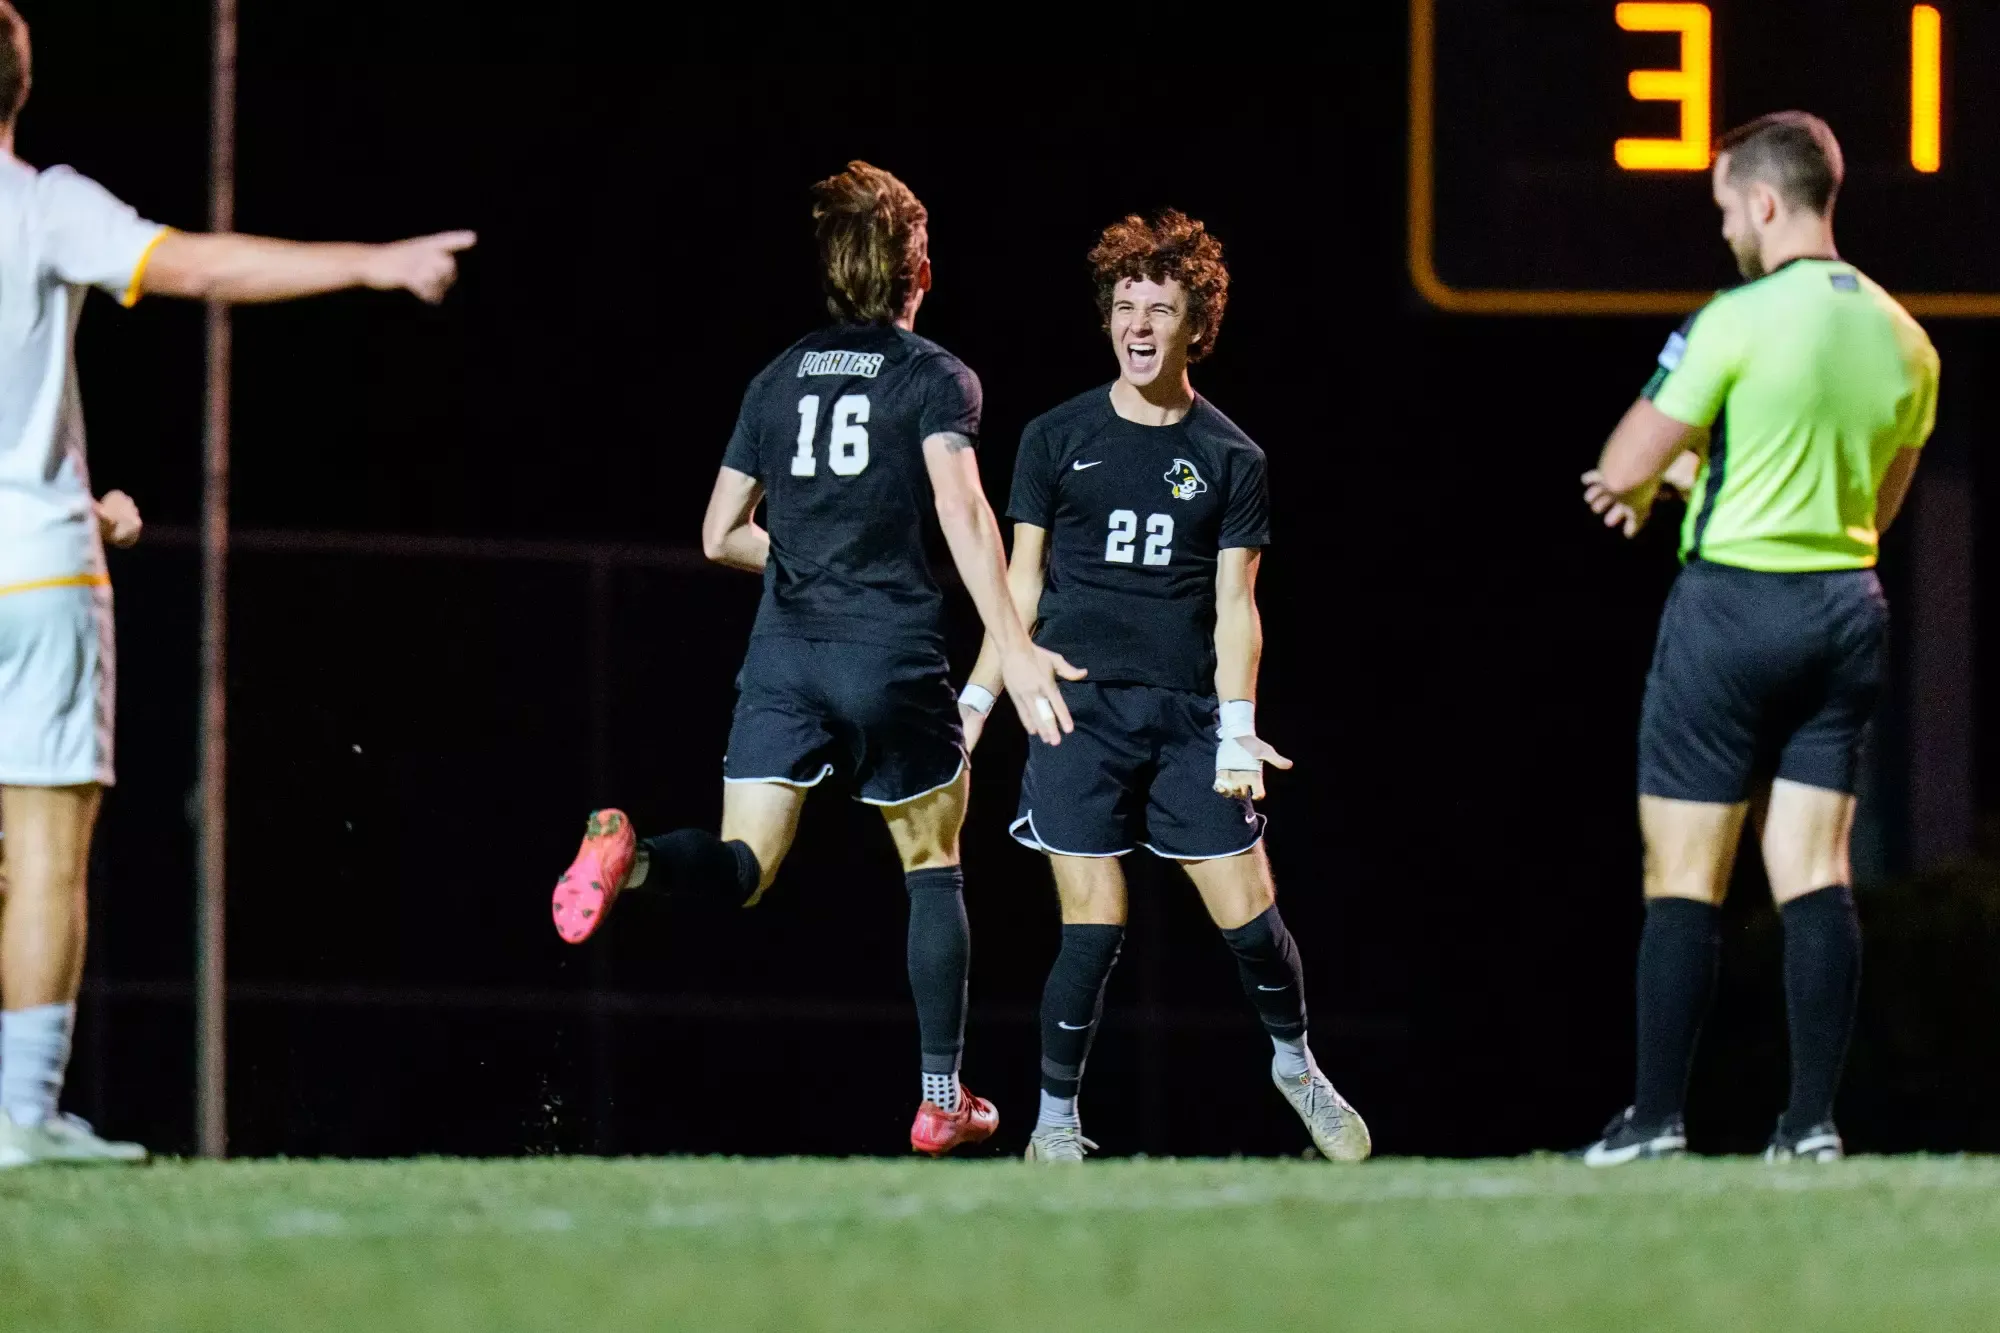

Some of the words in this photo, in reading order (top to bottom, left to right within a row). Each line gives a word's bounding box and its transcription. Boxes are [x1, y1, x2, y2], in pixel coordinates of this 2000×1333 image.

[1614, 2, 1712, 170] 3
[1910, 4, 1941, 173] 1
[797, 350, 884, 378] PIRATES
[791, 394, 870, 476] 16
[1105, 510, 1174, 566] 22
